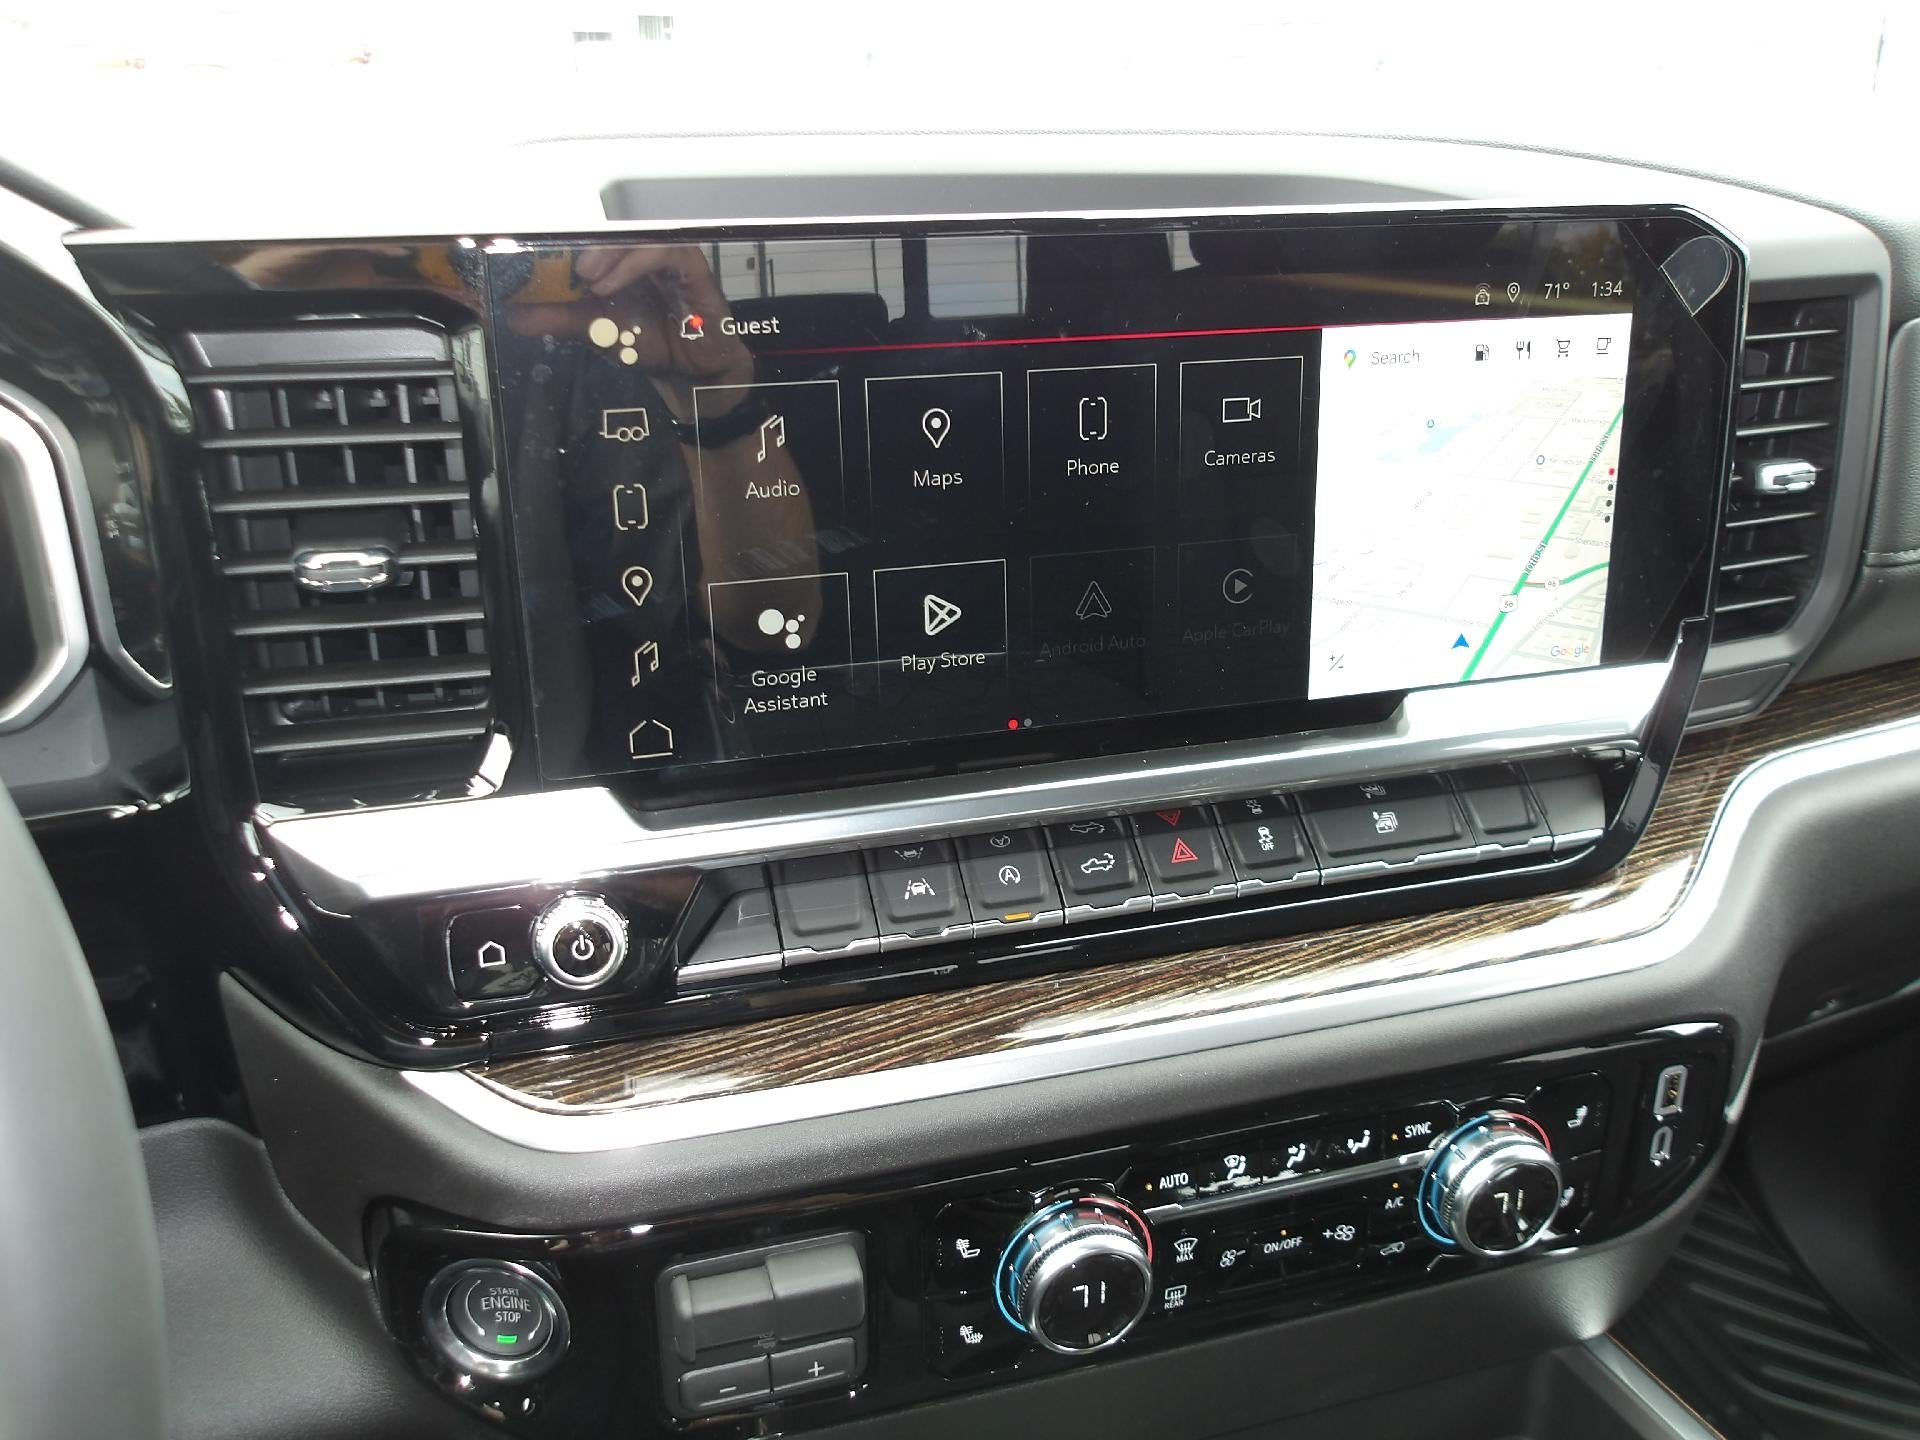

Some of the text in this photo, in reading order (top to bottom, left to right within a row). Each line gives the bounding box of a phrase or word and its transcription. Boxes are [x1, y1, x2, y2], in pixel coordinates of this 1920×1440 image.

[1591, 280, 1623, 298] 1:34
[720, 316, 781, 336] Guest
[1370, 349, 1421, 367] Search
[1204, 449, 1276, 466] Cameras
[1067, 459, 1120, 477] Phone
[913, 469, 963, 490] Maps
[745, 479, 801, 499] Audio
[1182, 619, 1291, 645] Apple CarPlay
[1039, 634, 1147, 658] Android Auto
[1550, 642, 1591, 658] Google
[901, 651, 986, 674] Play Store
[751, 666, 817, 689] Google
[744, 691, 829, 714] Assistant
[1260, 842, 1275, 852] OFF
[1404, 1121, 1433, 1139] SYNC
[1159, 1172, 1189, 1190] AUTO
[1384, 1196, 1404, 1210] A/C
[1493, 1189, 1524, 1214] 71
[1263, 1236, 1303, 1254] ON/OFF
[1175, 1252, 1195, 1263] MAX
[489, 1287, 520, 1296] START
[1072, 1281, 1106, 1308] 71
[481, 1296, 532, 1313] ENGINE
[1164, 1298, 1185, 1310] REAR
[495, 1311, 522, 1323] STOP
